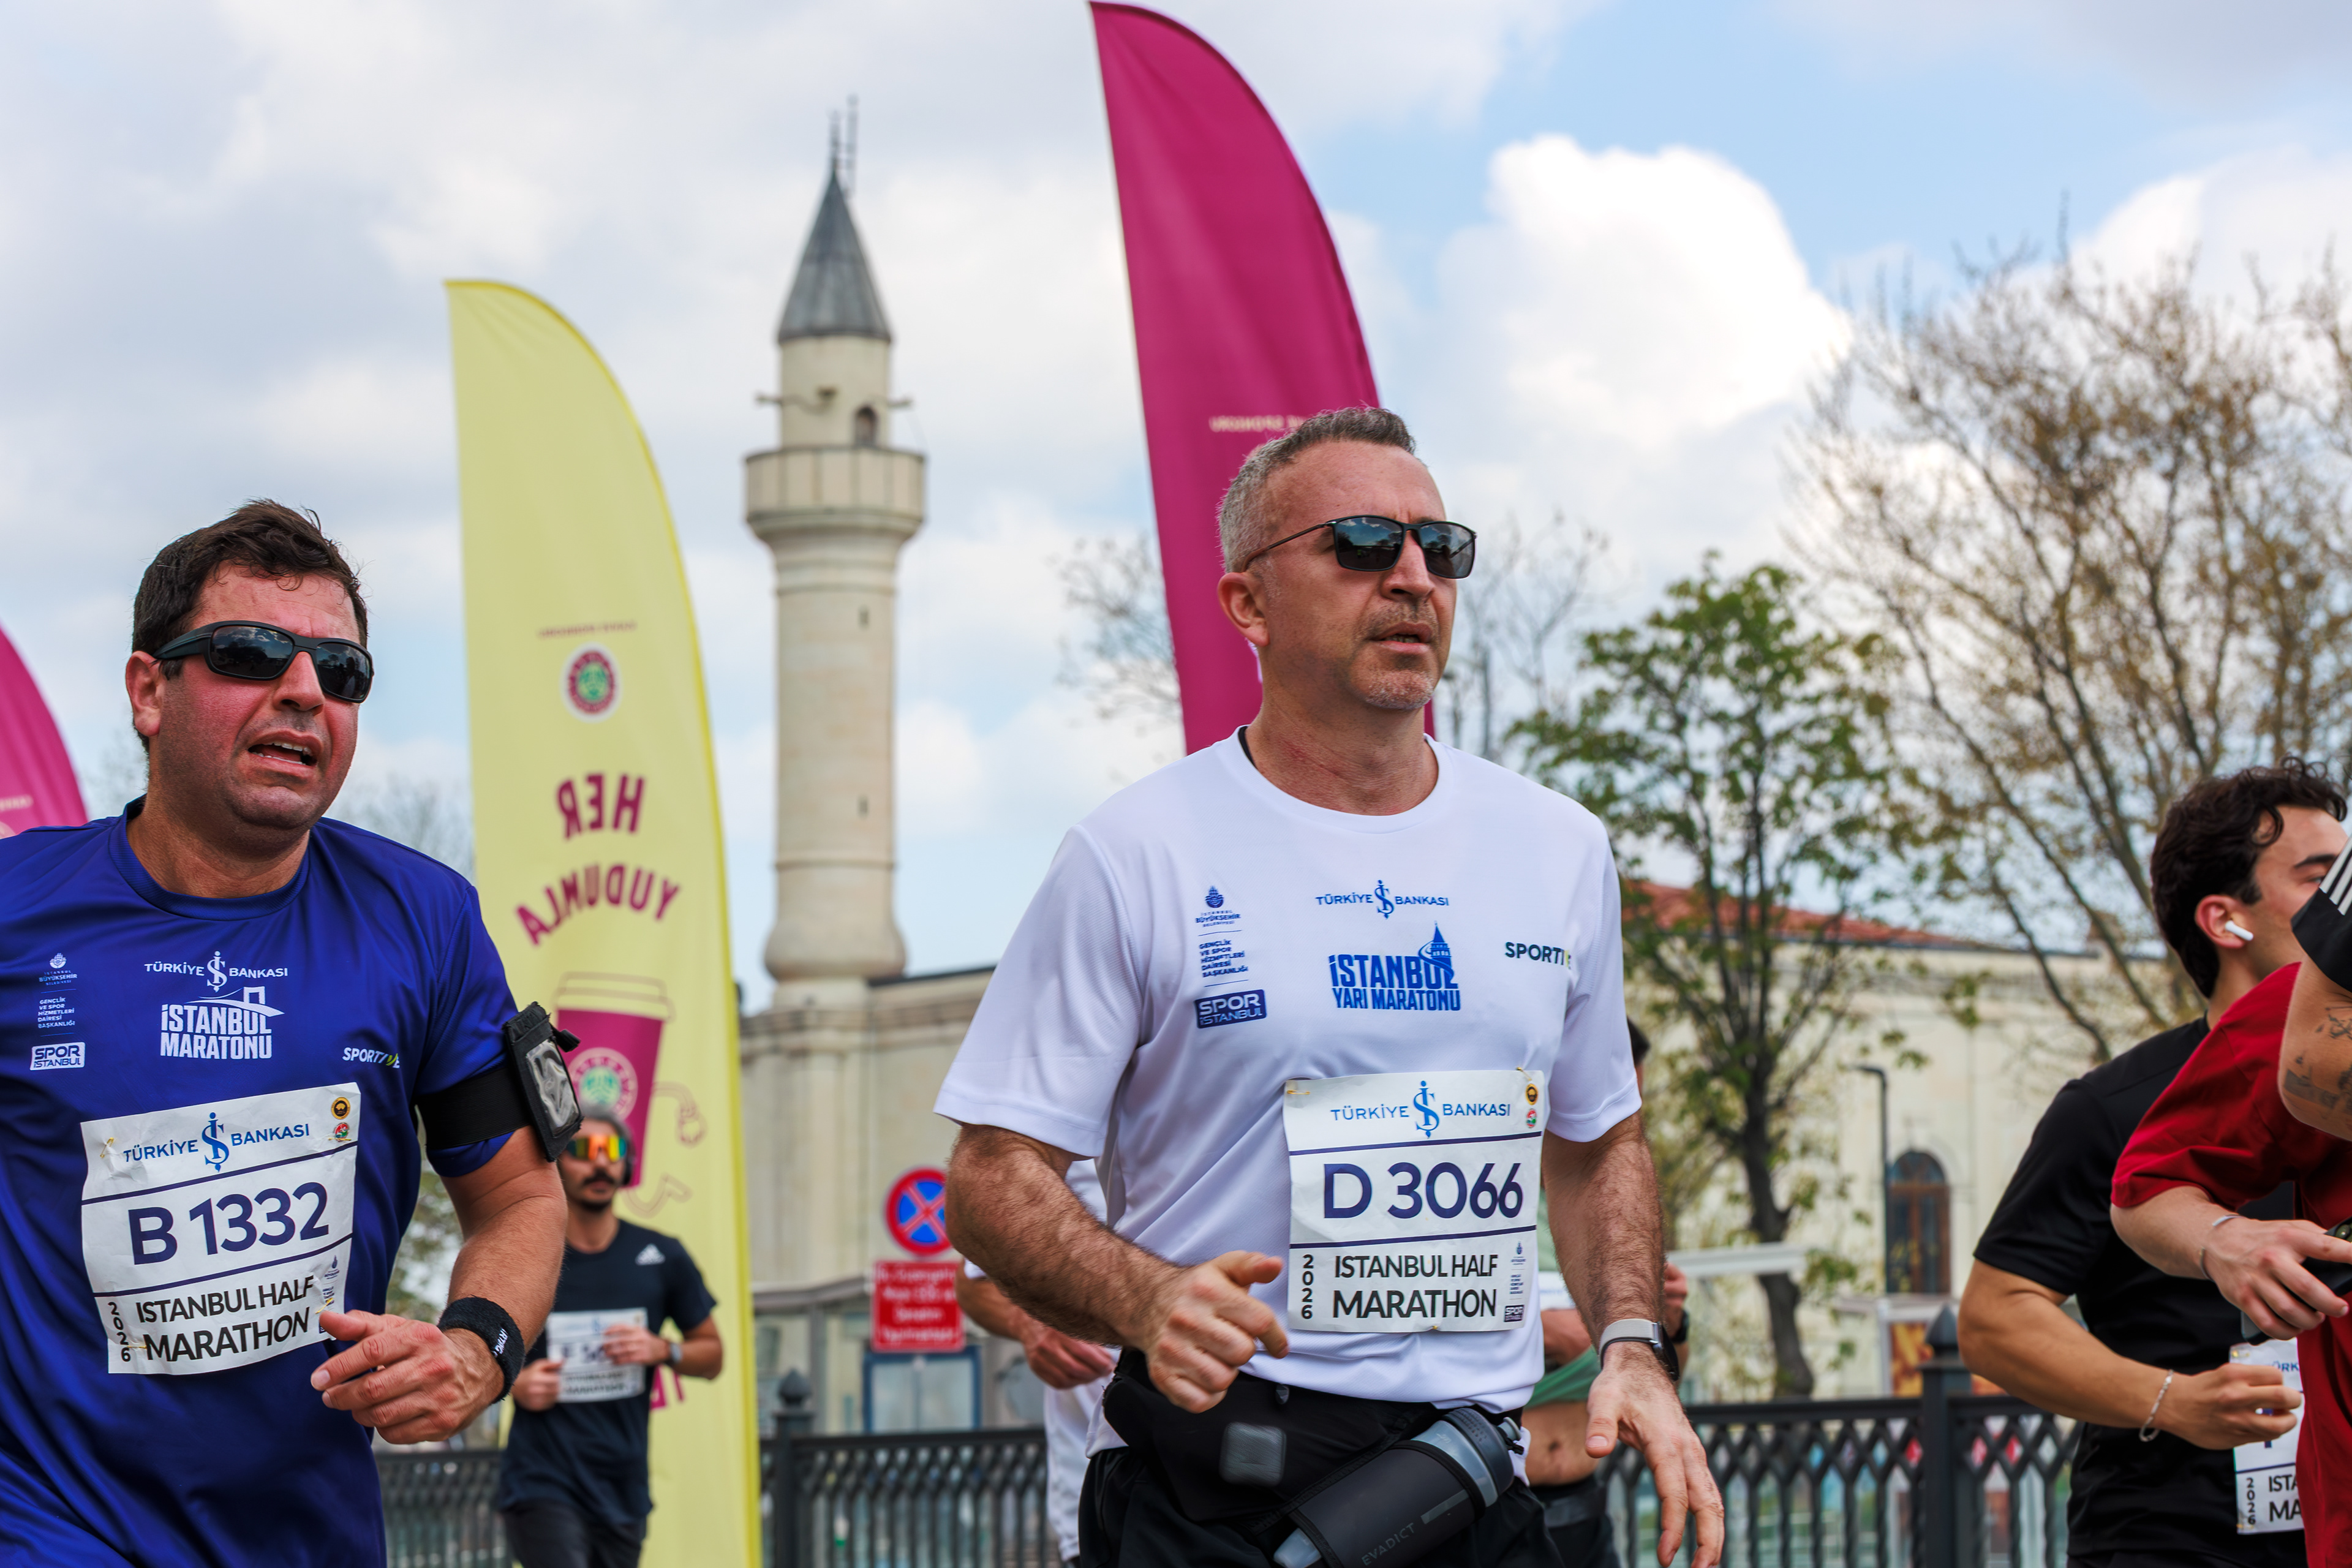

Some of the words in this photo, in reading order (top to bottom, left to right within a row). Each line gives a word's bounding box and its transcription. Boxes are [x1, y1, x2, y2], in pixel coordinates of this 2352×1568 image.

[1316, 892, 1373, 905] TÜRKİYE
[1395, 896, 1449, 906] BANKASI
[144, 961, 205, 976] TÜRKİYE
[229, 967, 288, 979] BANKASI
[38, 1008, 75, 1016] HİZMETLERİ
[1199, 993, 1262, 1016] SPOR
[1332, 987, 1368, 1009] YARI
[1371, 989, 1461, 1011] MARATONU
[160, 1004, 272, 1035] İSTANBUL
[35, 1044, 80, 1060] SPOR
[160, 1032, 272, 1060] MARATONU
[1330, 1103, 1409, 1121] TÜRKİYE
[1442, 1103, 1511, 1117] BANKASI
[123, 1138, 199, 1163] TÜRKİYE
[231, 1123, 310, 1147] BANKASI
[1324, 1163, 1373, 1219] D
[1387, 1162, 1523, 1219] 3066
[128, 1206, 178, 1265] B
[189, 1182, 330, 1256] 1332
[1334, 1254, 1448, 1278] ISTANBUL
[1452, 1254, 1498, 1277] HALF
[135, 1287, 257, 1323] ISTANBUL
[258, 1275, 314, 1308] HALF
[1301, 1254, 1314, 1319] 2026
[1332, 1289, 1497, 1319] MARATHON
[108, 1302, 132, 1363] 2026
[143, 1306, 310, 1362] MARATHON
[2246, 1477, 2256, 1525] 2026
[2269, 1499, 2302, 1523] MA
[1362, 1522, 1415, 1566] EVADICT
